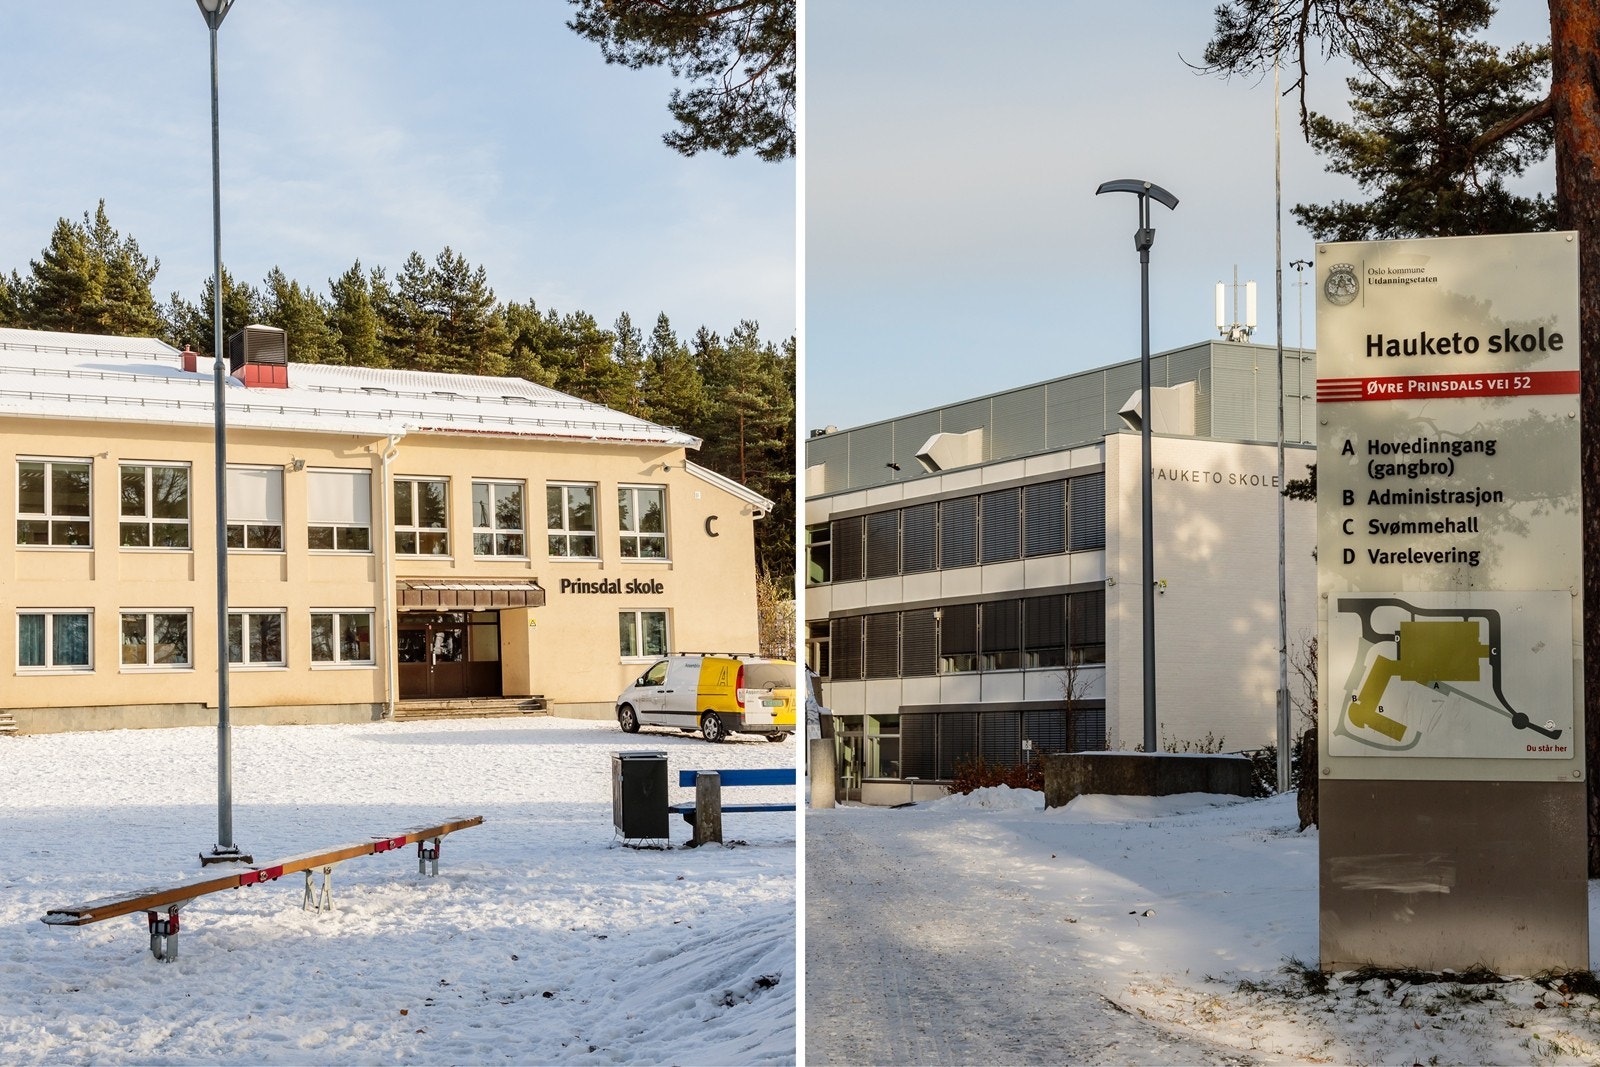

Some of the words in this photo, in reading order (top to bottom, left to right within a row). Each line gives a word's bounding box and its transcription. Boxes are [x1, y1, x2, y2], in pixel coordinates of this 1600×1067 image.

[1367, 267, 1386, 275] Oslo
[1387, 266, 1425, 275] kommune
[1368, 275, 1438, 285] Utdanningsetaten
[1367, 332, 1479, 357] Hauketo
[1488, 327, 1563, 353] skole
[1409, 380, 1483, 392] PRINSDALS
[1514, 377, 1530, 389] 52
[1342, 440, 1354, 455] A
[1367, 438, 1497, 456] Hovedinngang
[1367, 458, 1455, 479] (gangbro)
[1228, 472, 1278, 487] SKOLE
[1343, 490, 1354, 505] B
[1367, 487, 1504, 507] Administrasjon
[705, 516, 719, 537] C
[1343, 519, 1354, 535] C
[1369, 517, 1478, 535] Svømmehall
[1344, 549, 1355, 564] D
[1368, 547, 1480, 567] Varelevering
[561, 578, 622, 594] Prinsdal
[626, 578, 663, 594] skole
[1433, 682, 1440, 690] A
[1378, 705, 1384, 713] B
[1526, 744, 1537, 752] Du
[1538, 744, 1553, 752] står
[1554, 744, 1568, 753] her
